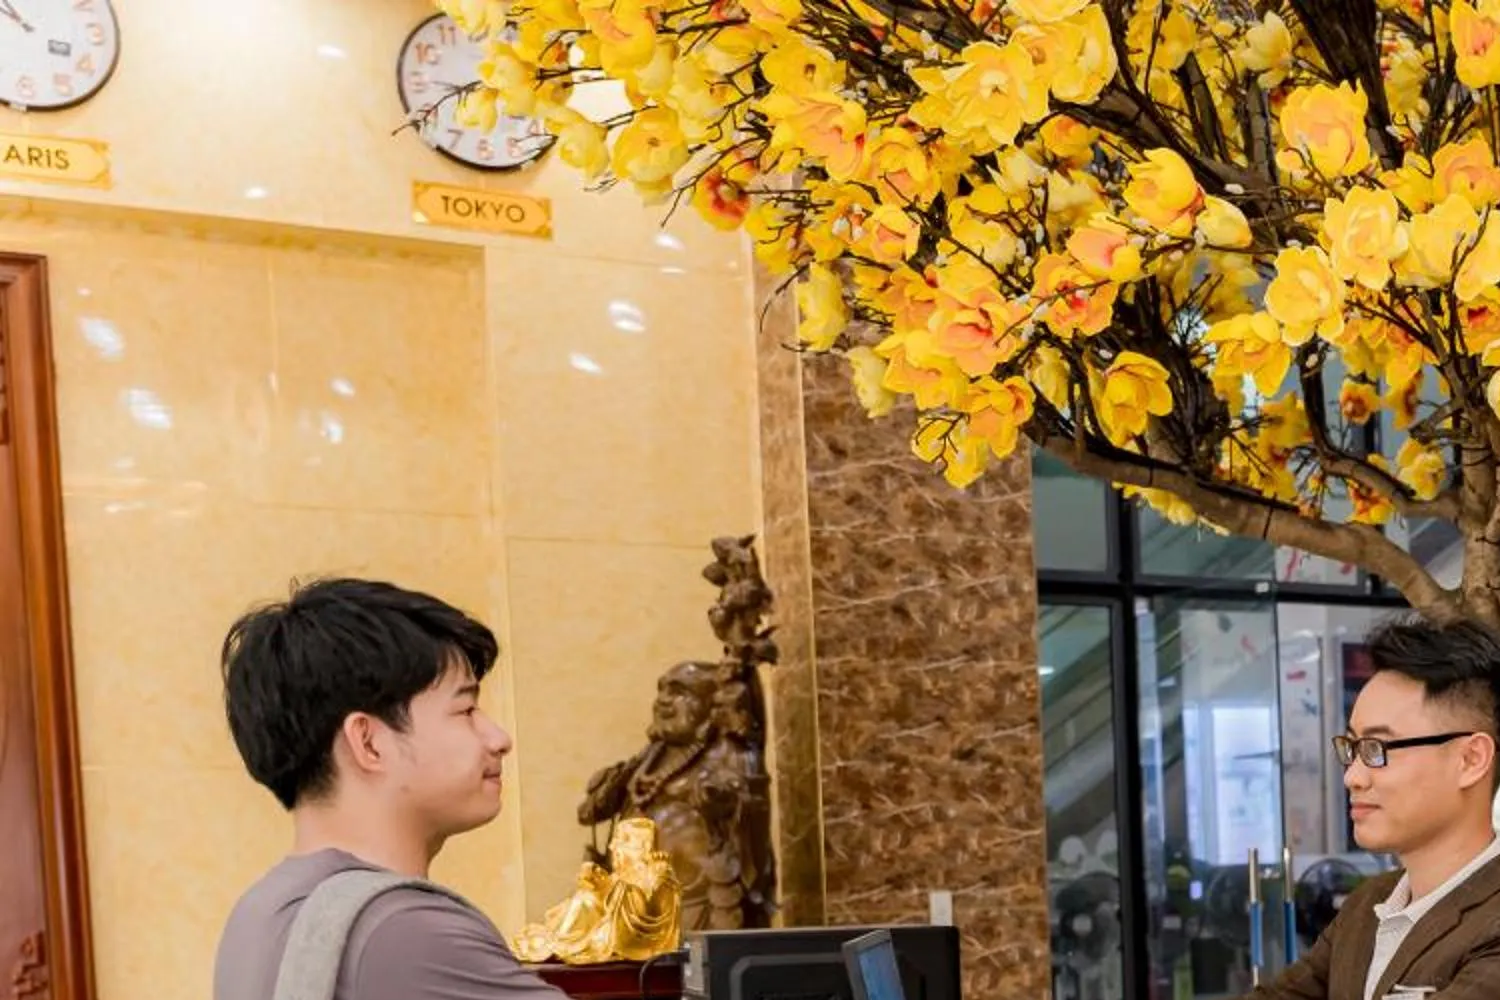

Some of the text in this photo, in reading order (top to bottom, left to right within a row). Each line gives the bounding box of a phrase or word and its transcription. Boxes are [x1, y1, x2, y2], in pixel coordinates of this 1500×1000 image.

[86, 22, 105, 46] 3
[437, 23, 457, 47] 11
[75, 52, 96, 77] 4
[447, 128, 464, 150] 7
[3, 143, 71, 171] ARIS
[440, 194, 526, 223] TOKYO
